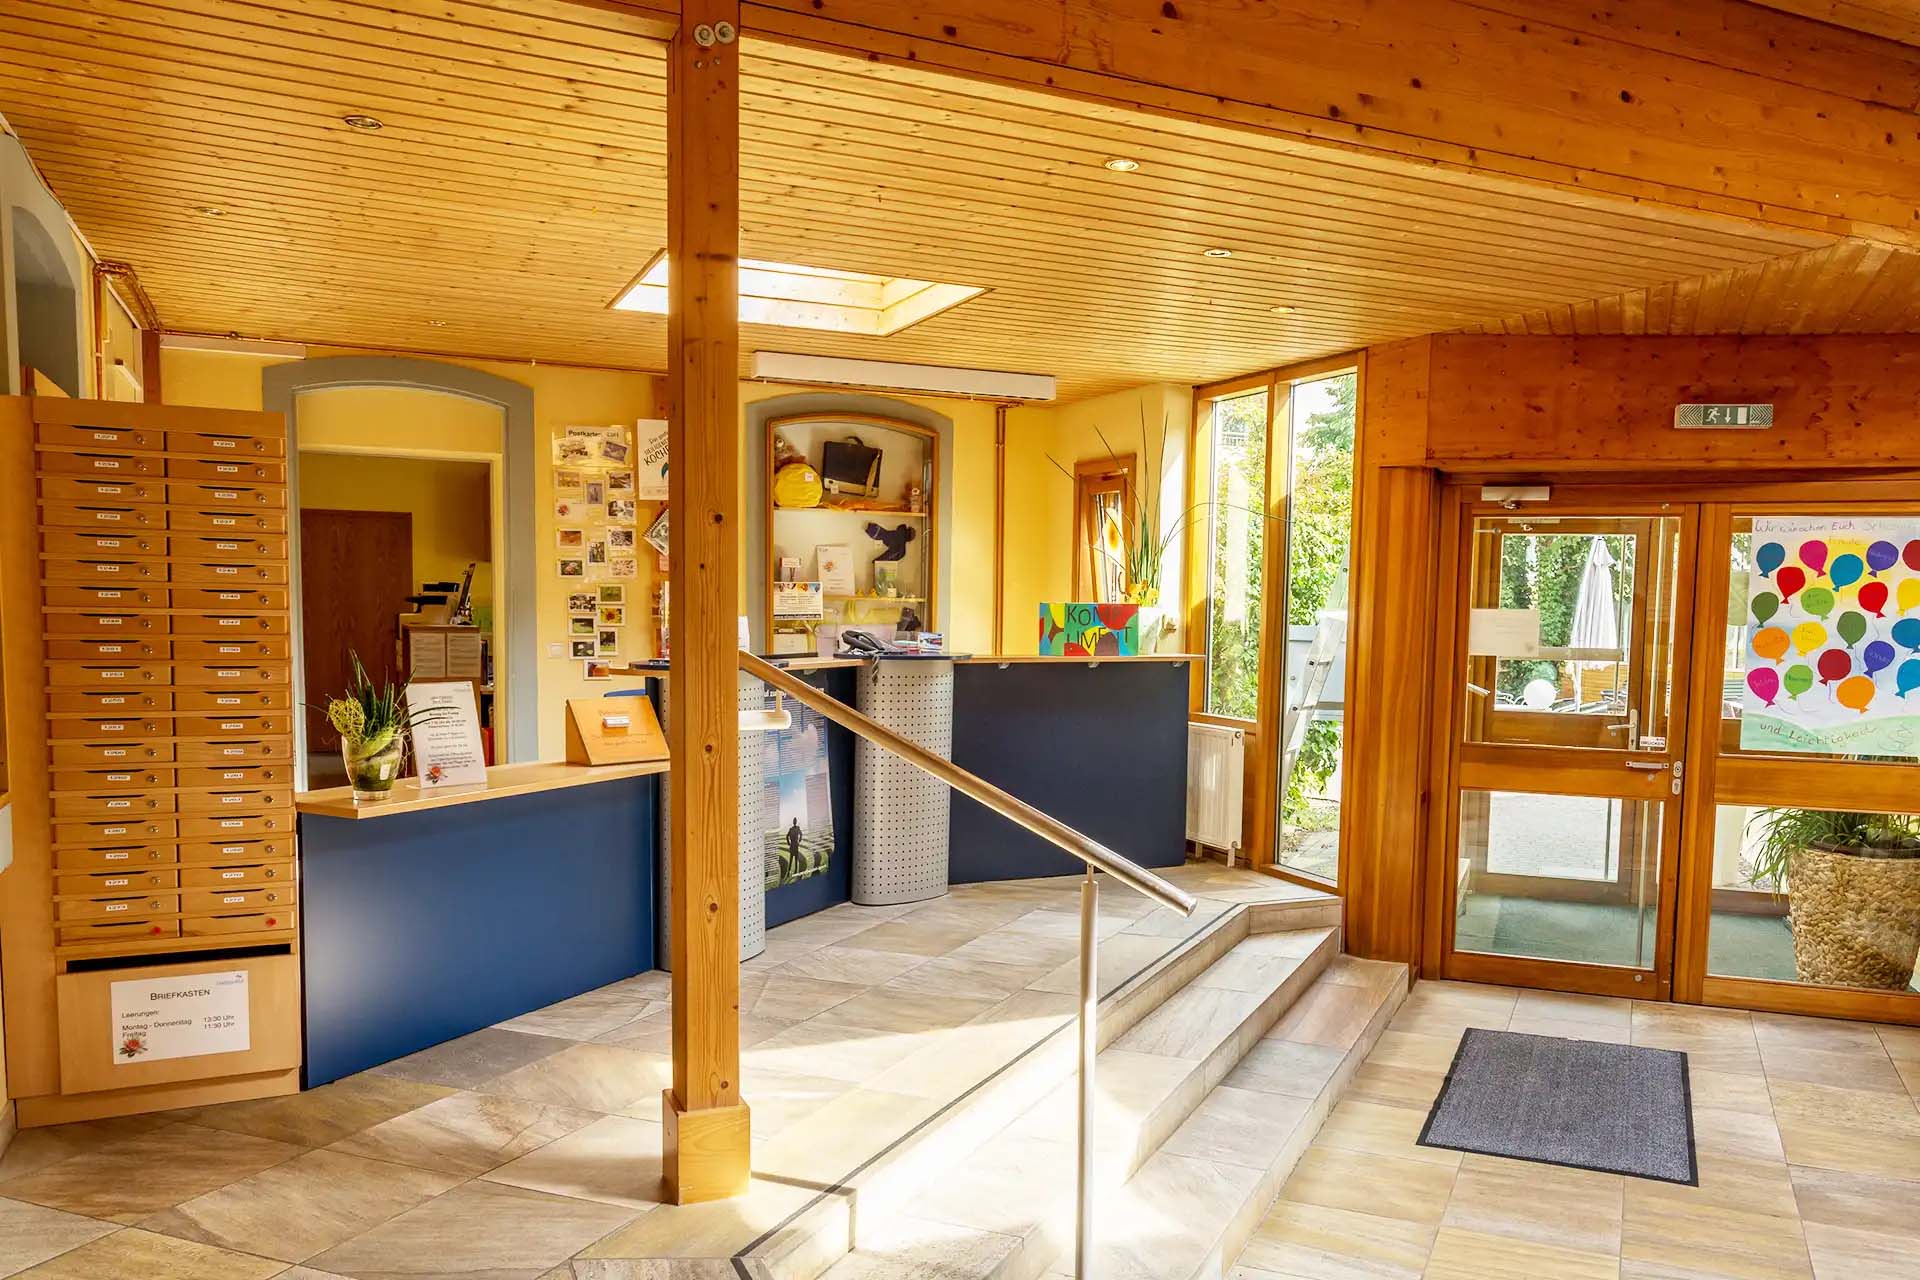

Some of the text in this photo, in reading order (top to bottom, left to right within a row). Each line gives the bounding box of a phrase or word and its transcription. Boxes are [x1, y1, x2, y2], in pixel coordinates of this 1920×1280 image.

[1754, 520, 1775, 533] Wir
[1831, 521, 1856, 531] Euch
[1760, 723, 1781, 735] und
[150, 988, 210, 1001] BRIEFKASTEN
[121, 1009, 160, 1019] Leerungen:
[122, 1023, 149, 1032] Montag
[153, 1018, 193, 1029] Donnerstag
[222, 1014, 235, 1022] Uhr
[122, 1030, 147, 1039] Freitag
